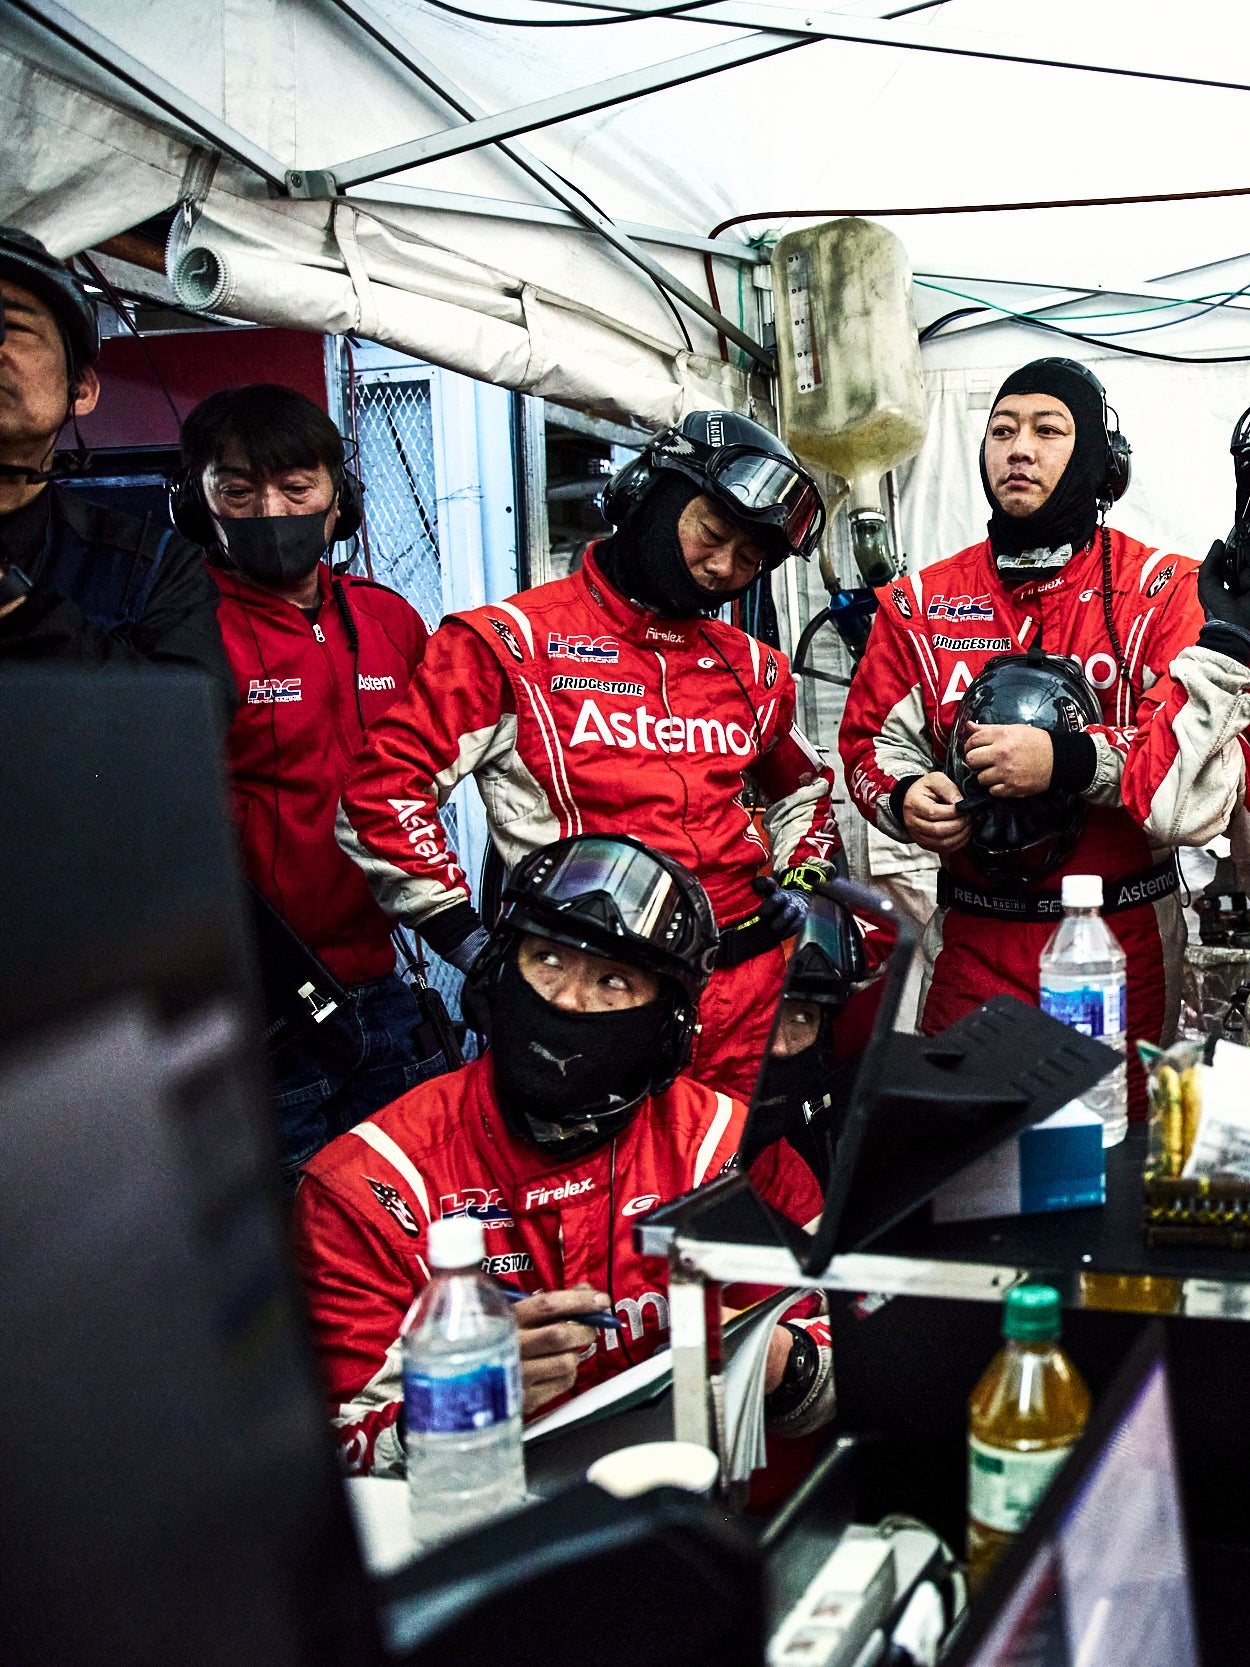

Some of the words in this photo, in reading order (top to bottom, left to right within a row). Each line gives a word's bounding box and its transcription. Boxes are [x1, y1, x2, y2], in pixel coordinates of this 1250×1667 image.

[927, 593, 993, 617] HRC
[548, 632, 619, 658] HRC
[551, 675, 645, 697] BRIDGESTONE
[569, 699, 751, 756] Astemo
[954, 887, 992, 909] REAL
[1117, 870, 1175, 906] Astemo
